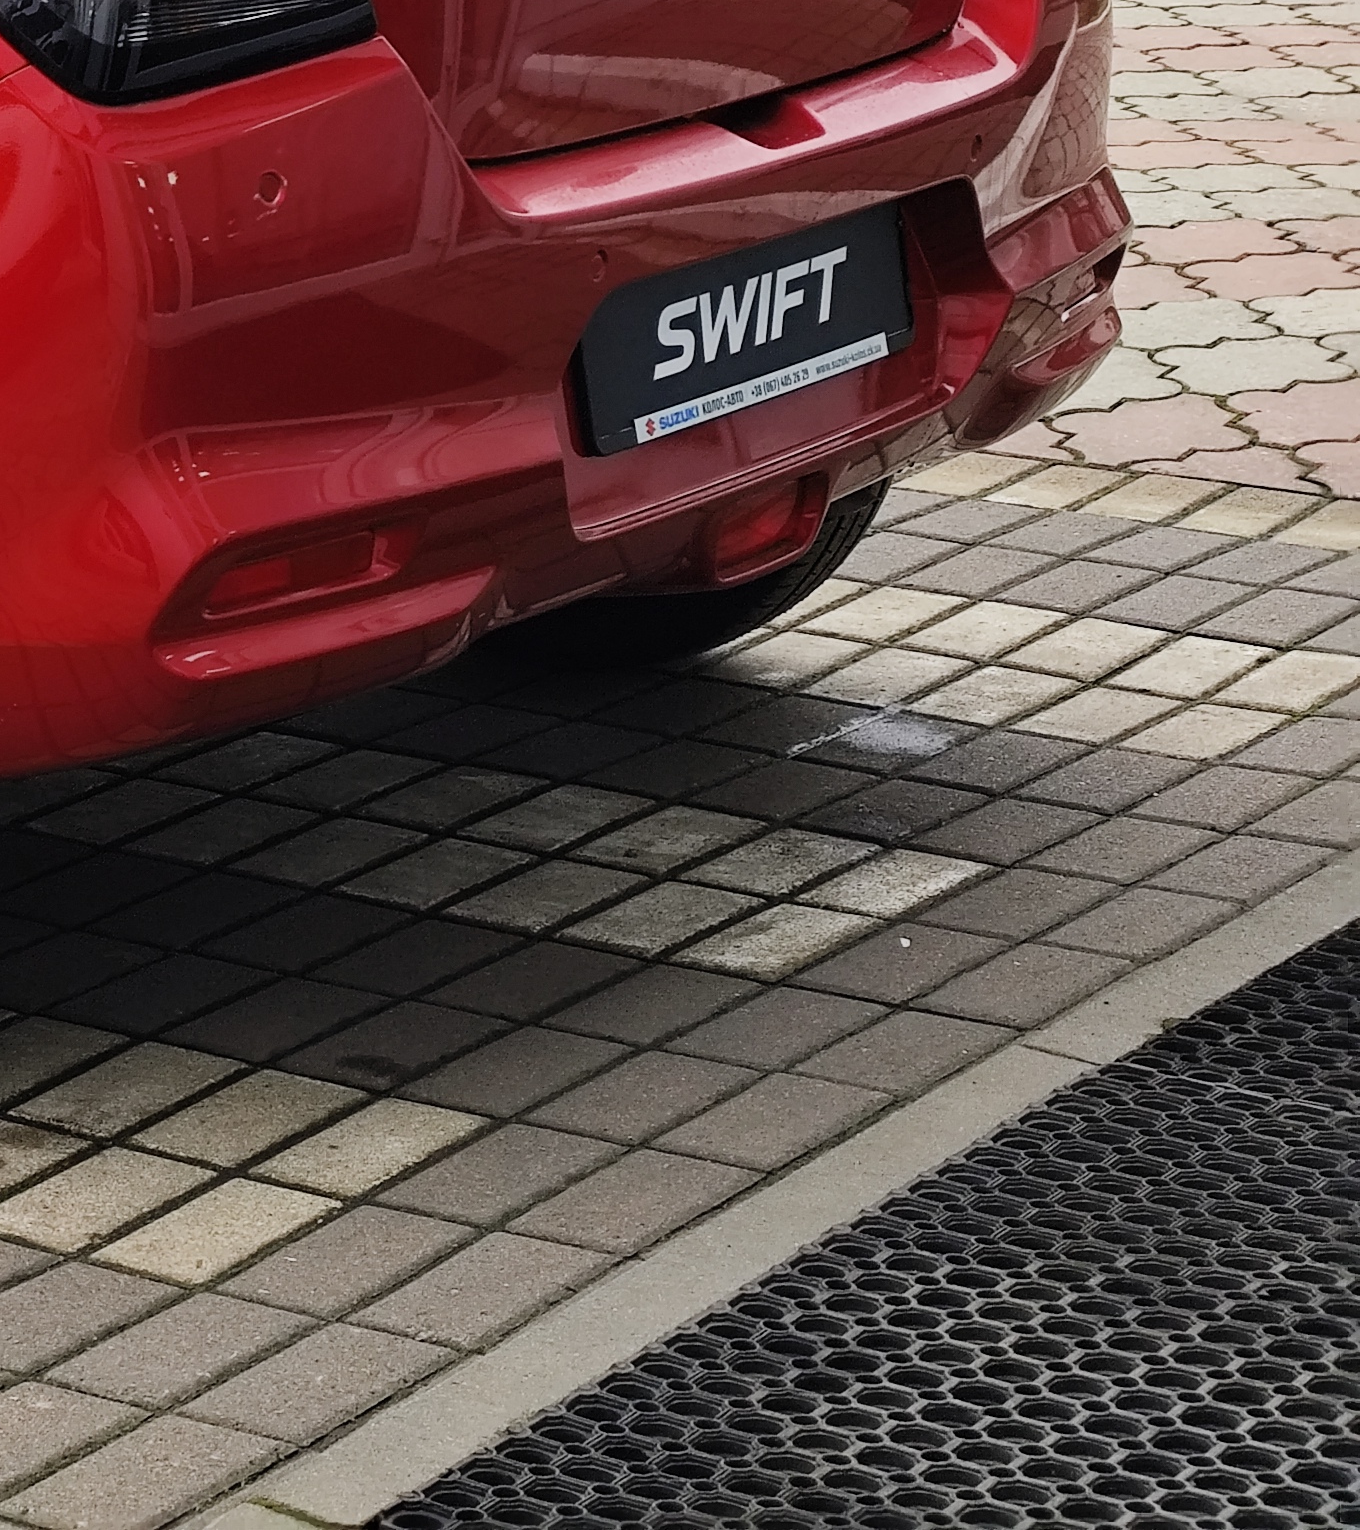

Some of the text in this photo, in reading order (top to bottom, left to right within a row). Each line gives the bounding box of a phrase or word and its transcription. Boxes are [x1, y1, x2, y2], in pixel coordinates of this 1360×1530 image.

[653, 246, 848, 381] SWIFT
[658, 405, 700, 430] SUZUKI
[702, 389, 744, 415] КОЛОС-АВТО
